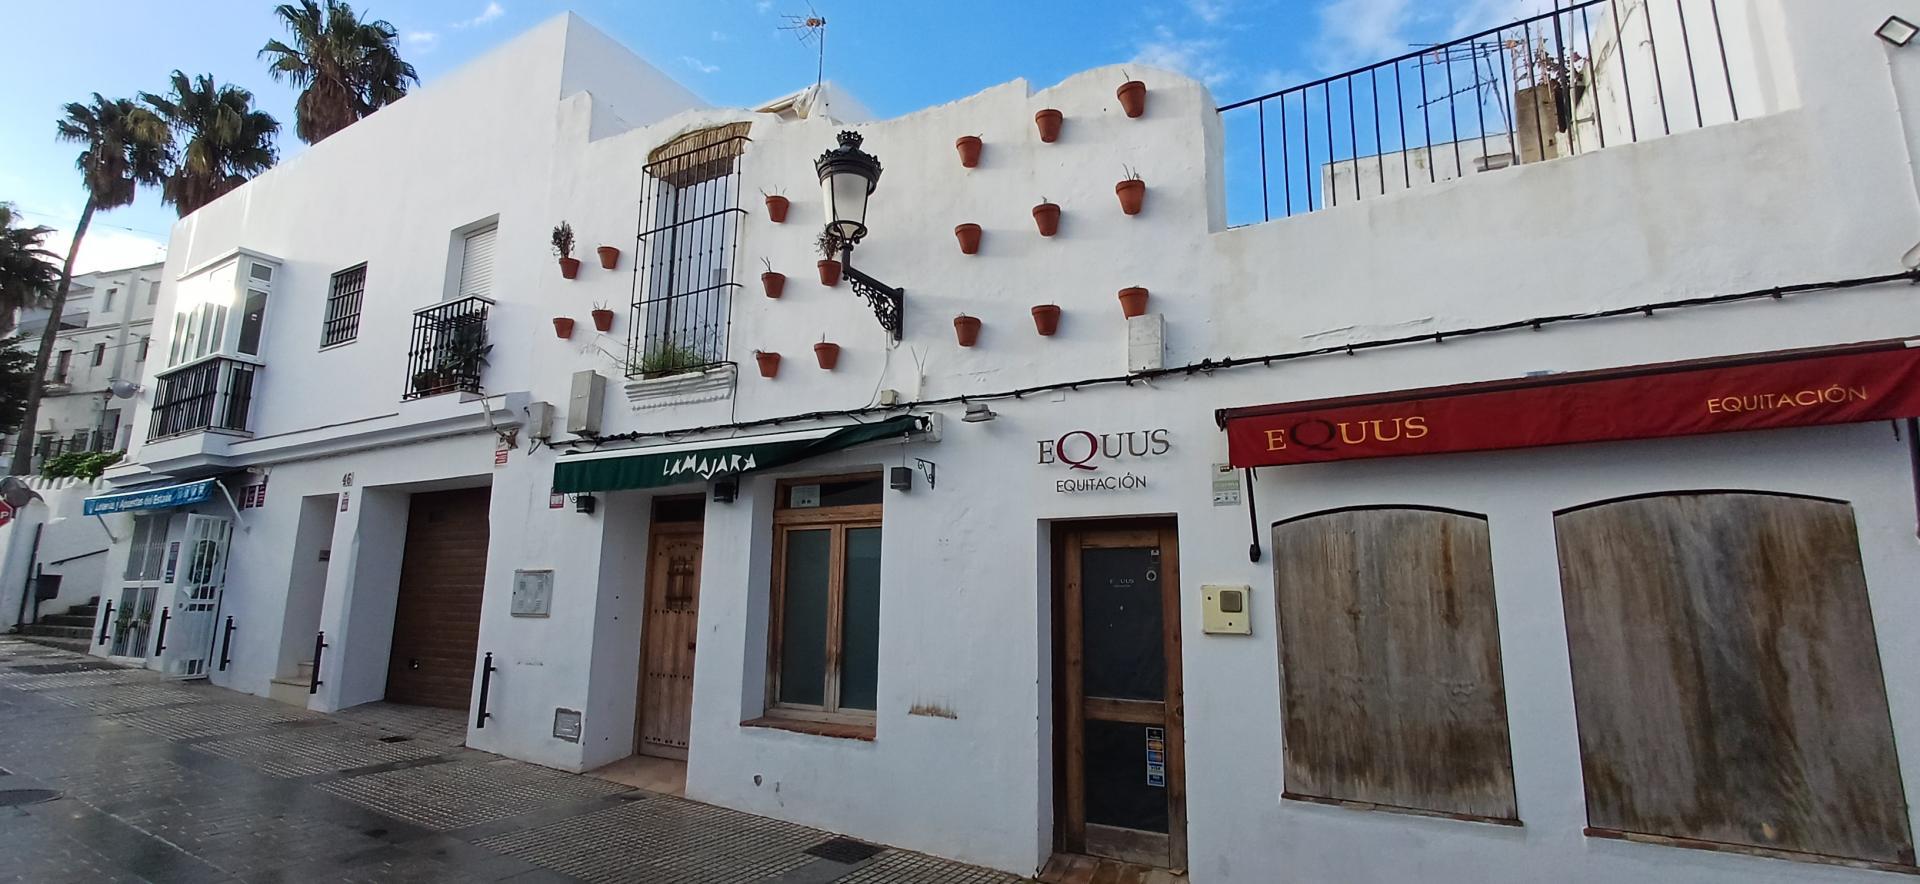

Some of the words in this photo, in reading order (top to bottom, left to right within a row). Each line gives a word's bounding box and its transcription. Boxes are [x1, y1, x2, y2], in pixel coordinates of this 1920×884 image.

[1707, 384, 1868, 414] EQUITACIÓN
[1264, 416, 1429, 452] EQUUS
[1037, 428, 1171, 471] EQUUS
[342, 472, 353, 486] 46
[1056, 472, 1147, 493] EQUITACIÓN
